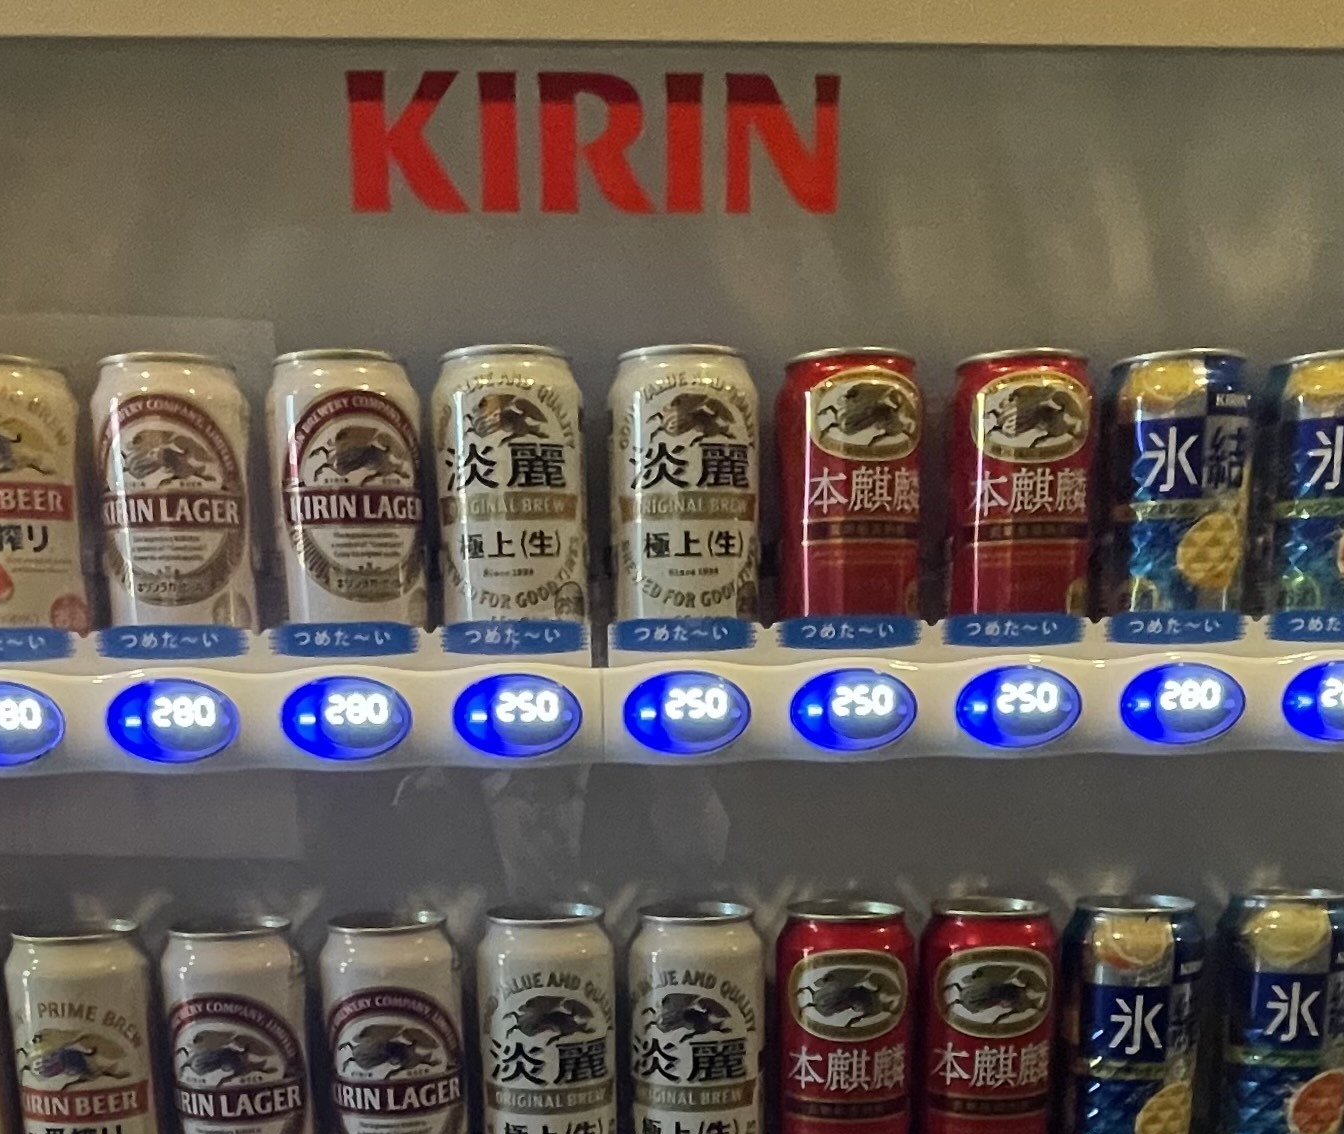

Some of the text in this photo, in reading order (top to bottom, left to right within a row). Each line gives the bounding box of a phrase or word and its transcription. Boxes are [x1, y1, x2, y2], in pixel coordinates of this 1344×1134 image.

[345, 70, 841, 215] KIRIN
[446, 442, 567, 491] 淡麗
[629, 442, 750, 490] 淡麗
[0, 489, 63, 512] BEER
[808, 466, 919, 514] 本麒麟
[968, 467, 1088, 517] 本麒麟
[160, 498, 239, 524] LAGER
[290, 494, 356, 522] KIRIN
[325, 693, 388, 724] 280
[496, 690, 559, 722] 250
[665, 688, 728, 719] 250
[832, 684, 894, 716] 250
[997, 682, 1058, 713] 250
[1160, 678, 1221, 710] 280
[152, 696, 216, 727] 280
[682, 969, 717, 990] AND
[38, 1001, 97, 1022] PRIME
[489, 1037, 606, 1086] 淡麗
[632, 1036, 748, 1084] 淡麗
[788, 1044, 905, 1093] 本麒麟
[931, 1041, 1049, 1088] 本麒麟
[75, 1090, 138, 1117] BEER
[220, 1086, 302, 1117] LAGER
[386, 1078, 461, 1111] LAGER
